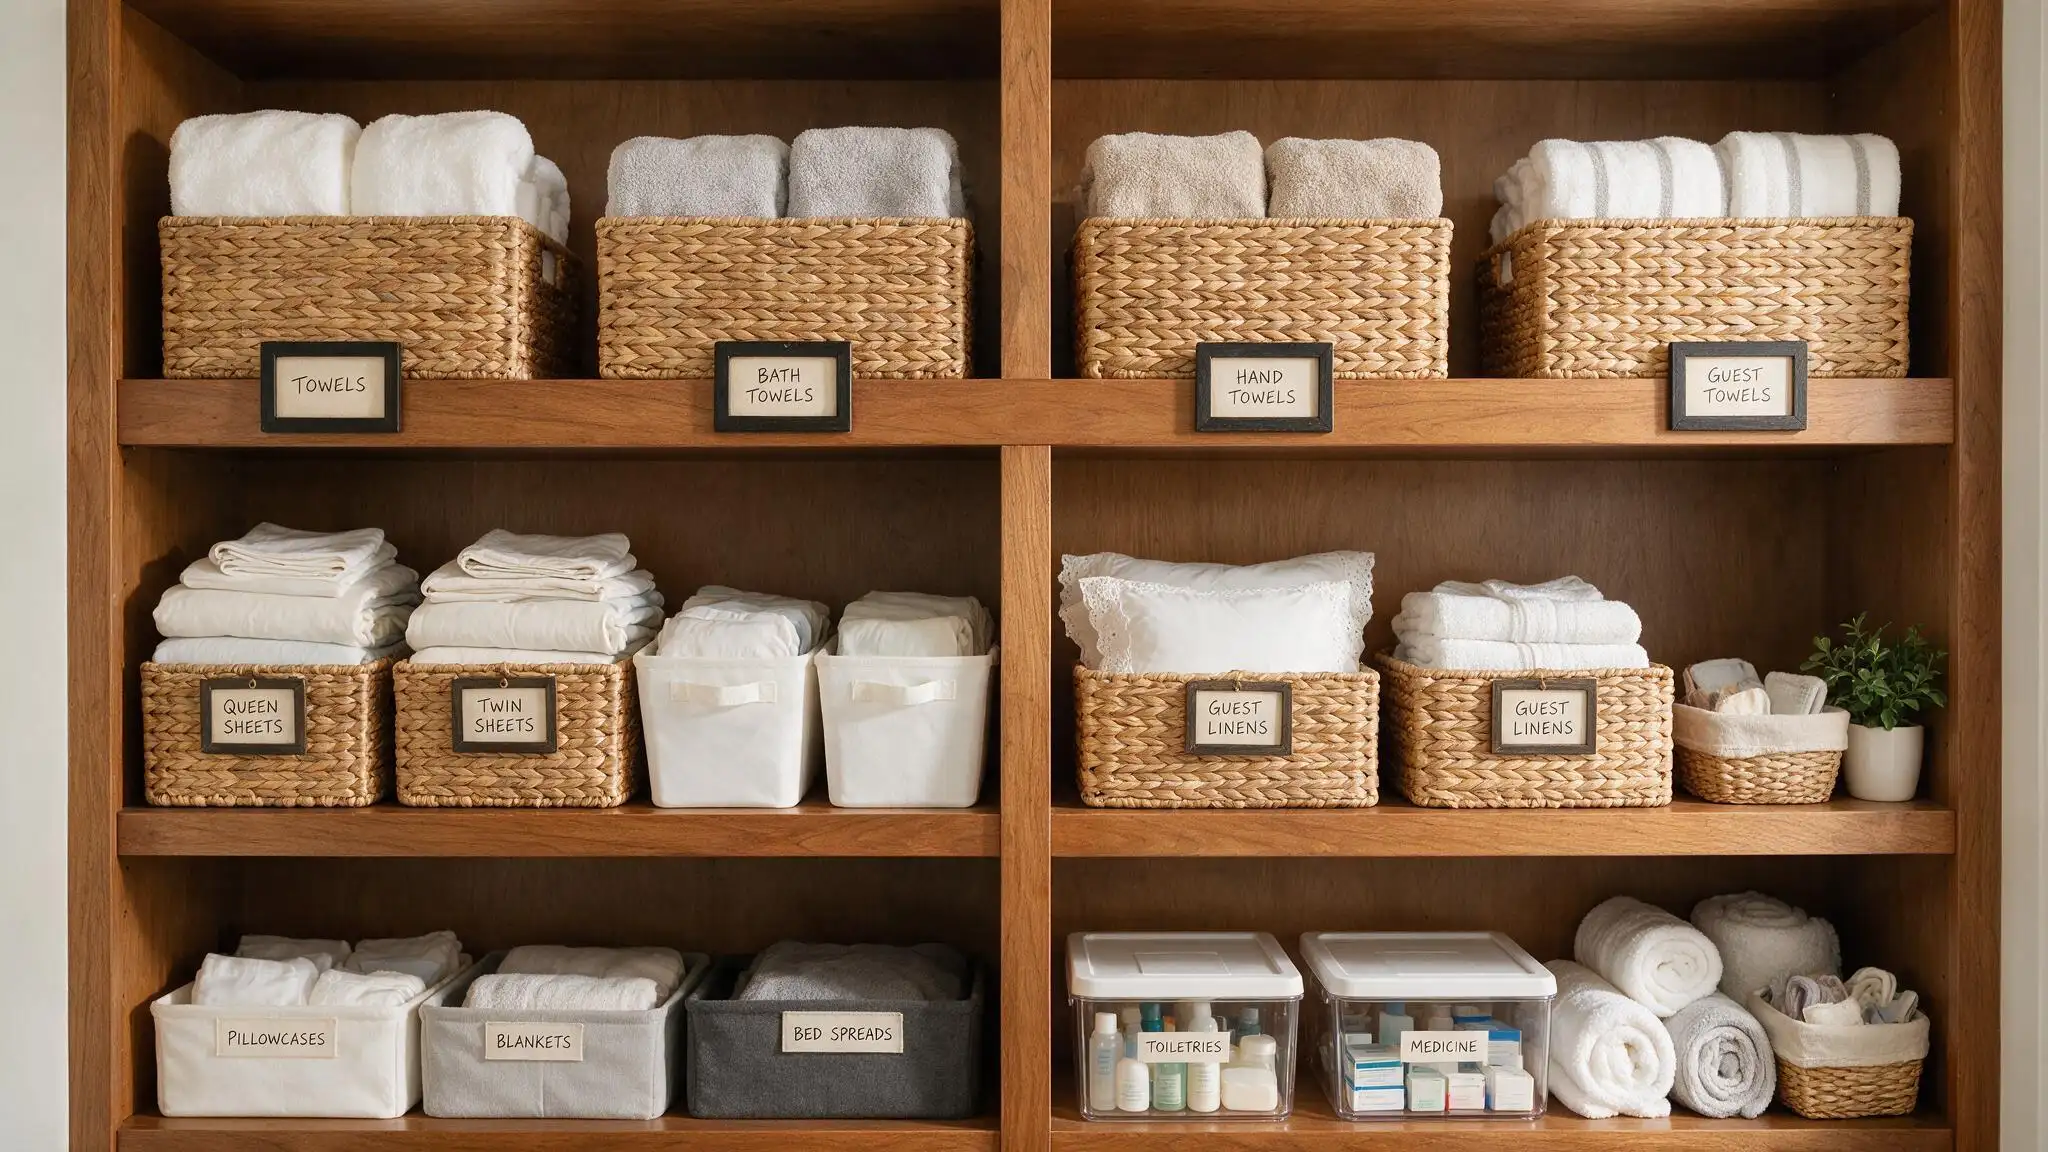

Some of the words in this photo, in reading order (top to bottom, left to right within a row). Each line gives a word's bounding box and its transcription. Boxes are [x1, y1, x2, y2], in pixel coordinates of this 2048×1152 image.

[757, 367, 800, 384] BATH
[1236, 368, 1283, 385] HAND
[1707, 366, 1763, 384] GUEST
[291, 376, 366, 395] TOWELS
[745, 387, 813, 404] TOWELS
[1228, 389, 1296, 405] TOWELS
[1703, 387, 1771, 404] TOWELS
[223, 698, 278, 716] QUEEN
[476, 697, 522, 713] TWIN
[1208, 699, 1263, 716] GUEST
[1515, 700, 1570, 717] GUEST
[223, 718, 283, 734] SHEETS
[474, 717, 534, 733] SHEETS
[1208, 720, 1268, 736] LINENS
[1513, 720, 1573, 736] LINENS
[228, 1030, 325, 1046] PILLOWCASES
[497, 1033, 571, 1049] BLANKETS
[793, 1026, 823, 1042] BED
[830, 1026, 893, 1042] SPREADS
[1146, 1040, 1222, 1053] TOILETRIES
[1410, 1039, 1477, 1054] MEDICINE
